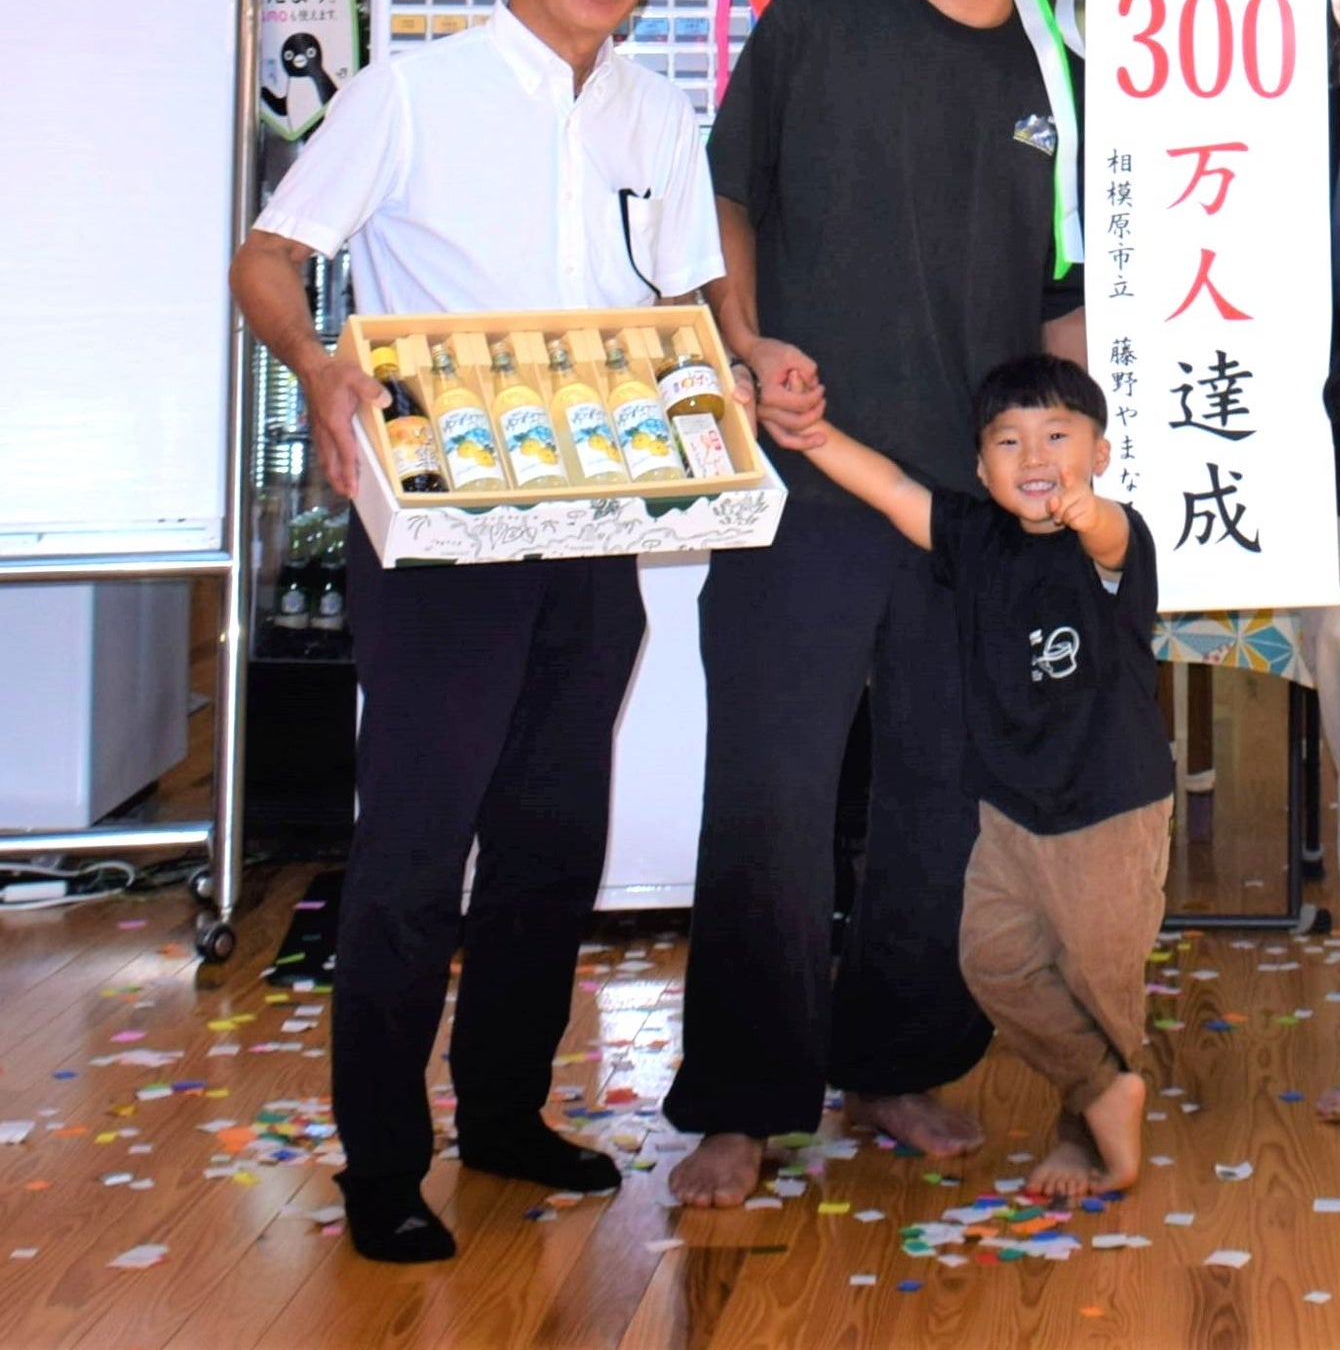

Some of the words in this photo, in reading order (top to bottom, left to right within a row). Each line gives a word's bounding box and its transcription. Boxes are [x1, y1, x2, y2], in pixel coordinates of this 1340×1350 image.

[1106, 148, 1136, 300] 相模原市立
[1109, 336, 1142, 508] 藤野やまな
